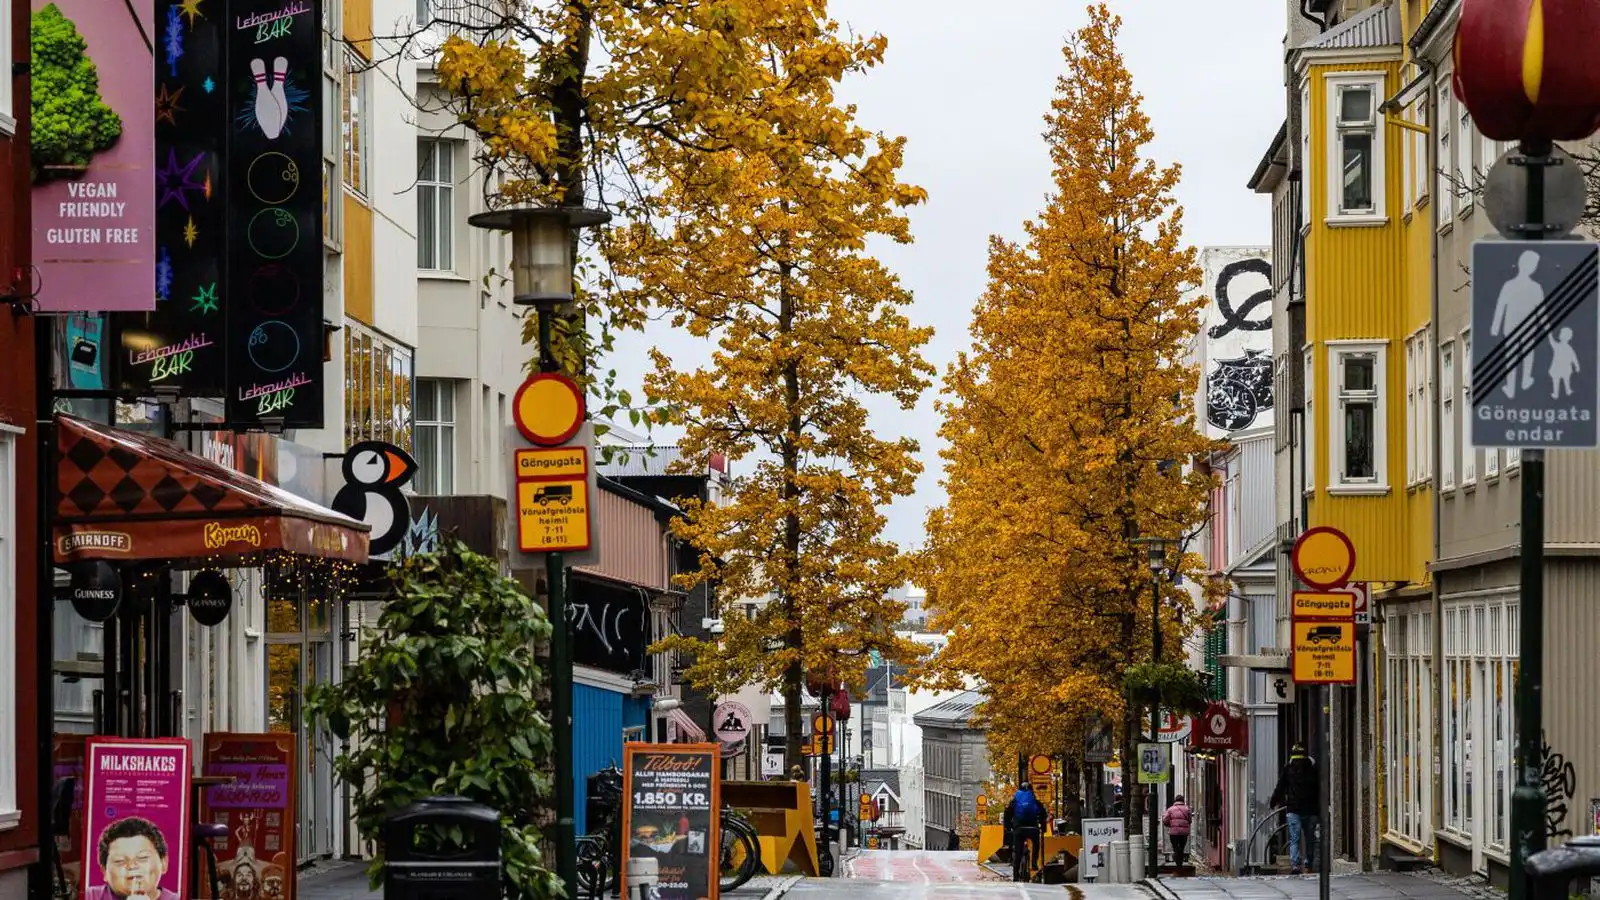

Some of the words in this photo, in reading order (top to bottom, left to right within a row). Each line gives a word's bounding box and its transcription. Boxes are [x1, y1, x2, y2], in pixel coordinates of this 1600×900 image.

[254, 16, 292, 44] BAR
[67, 182, 117, 198] VEGAN
[59, 202, 126, 217] FRIENDLY
[46, 228, 101, 244] GLUTEN
[105, 228, 138, 244] FREE
[149, 350, 193, 382] BAR
[256, 387, 295, 416] BAR
[1478, 404, 1591, 424] Göngugata
[1505, 424, 1563, 441] endar
[521, 456, 582, 468] Göngugata
[65, 535, 124, 550] SMIRNOFF
[75, 588, 114, 600] GUINNESS
[1296, 599, 1350, 610] Göngugata
[1203, 735, 1232, 744] Marmot
[101, 755, 176, 772] MILKSHAKES
[643, 755, 703, 771] Tilboð!
[634, 792, 677, 806] 1.850
[682, 792, 710, 806] KR.
